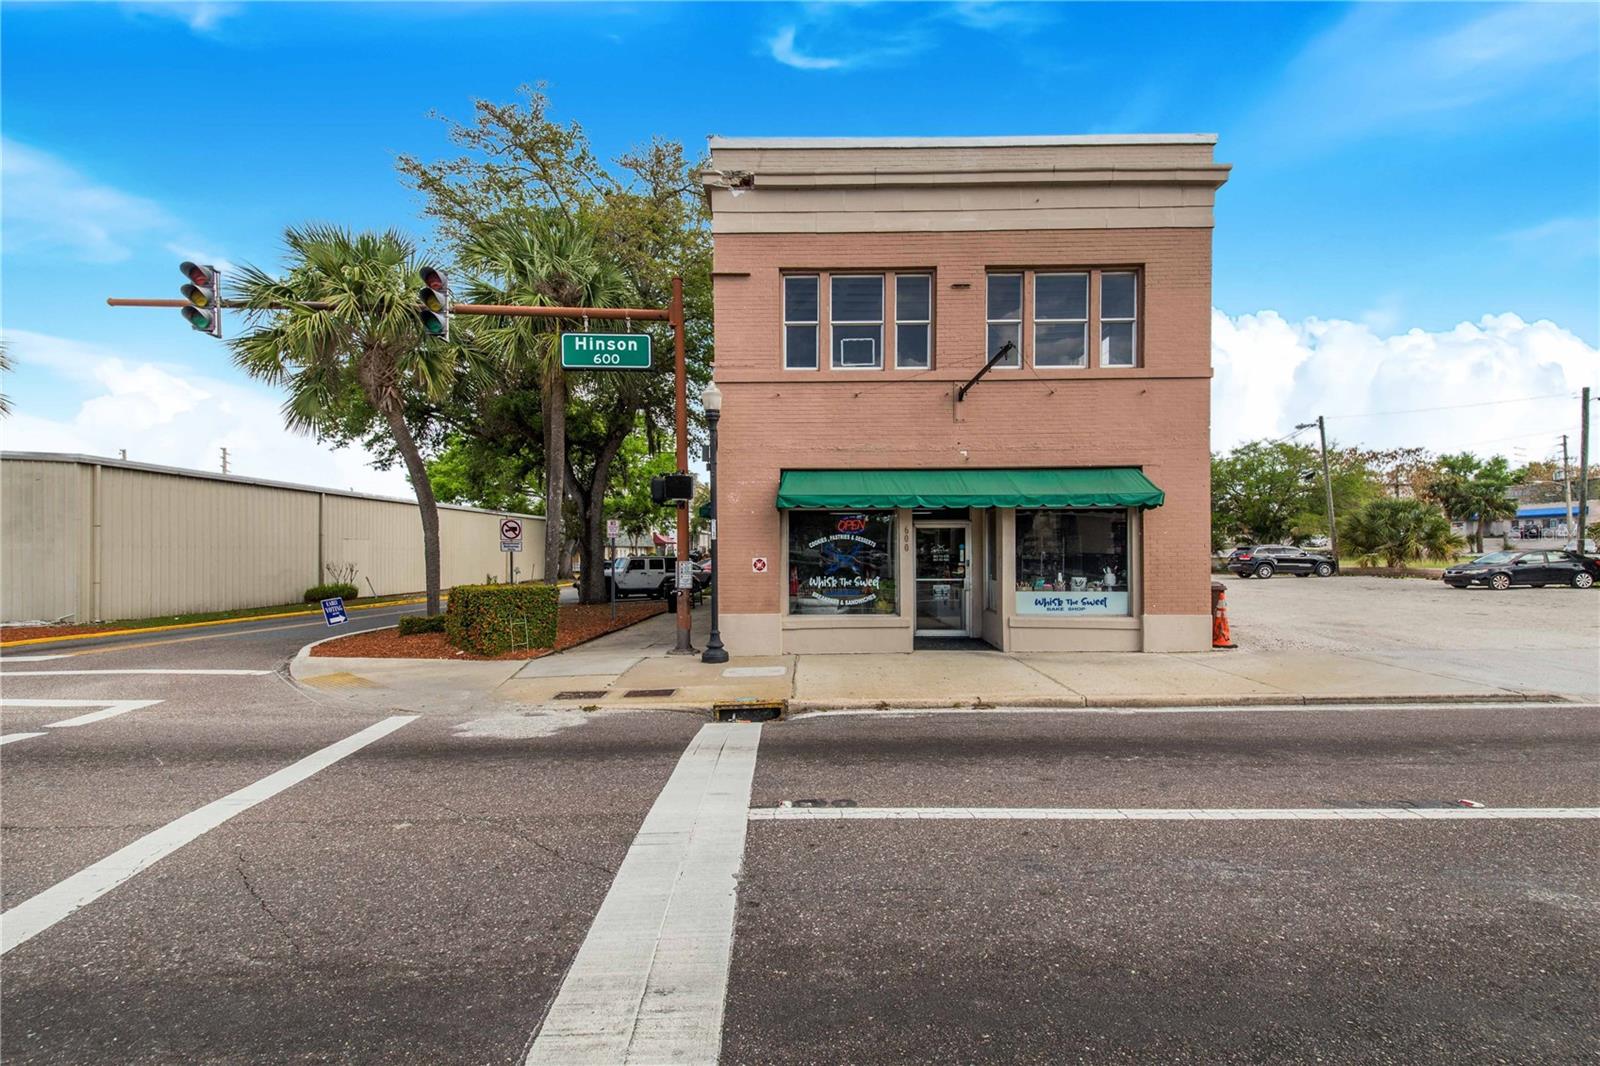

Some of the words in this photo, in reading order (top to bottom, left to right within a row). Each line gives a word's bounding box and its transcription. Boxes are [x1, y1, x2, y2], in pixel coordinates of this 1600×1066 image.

[575, 337, 637, 351] Hinson
[593, 354, 620, 364] 600
[838, 519, 865, 531] OPEN
[839, 577, 852, 587] The
[1065, 598, 1079, 606] The
[325, 605, 343, 614] VOTING
